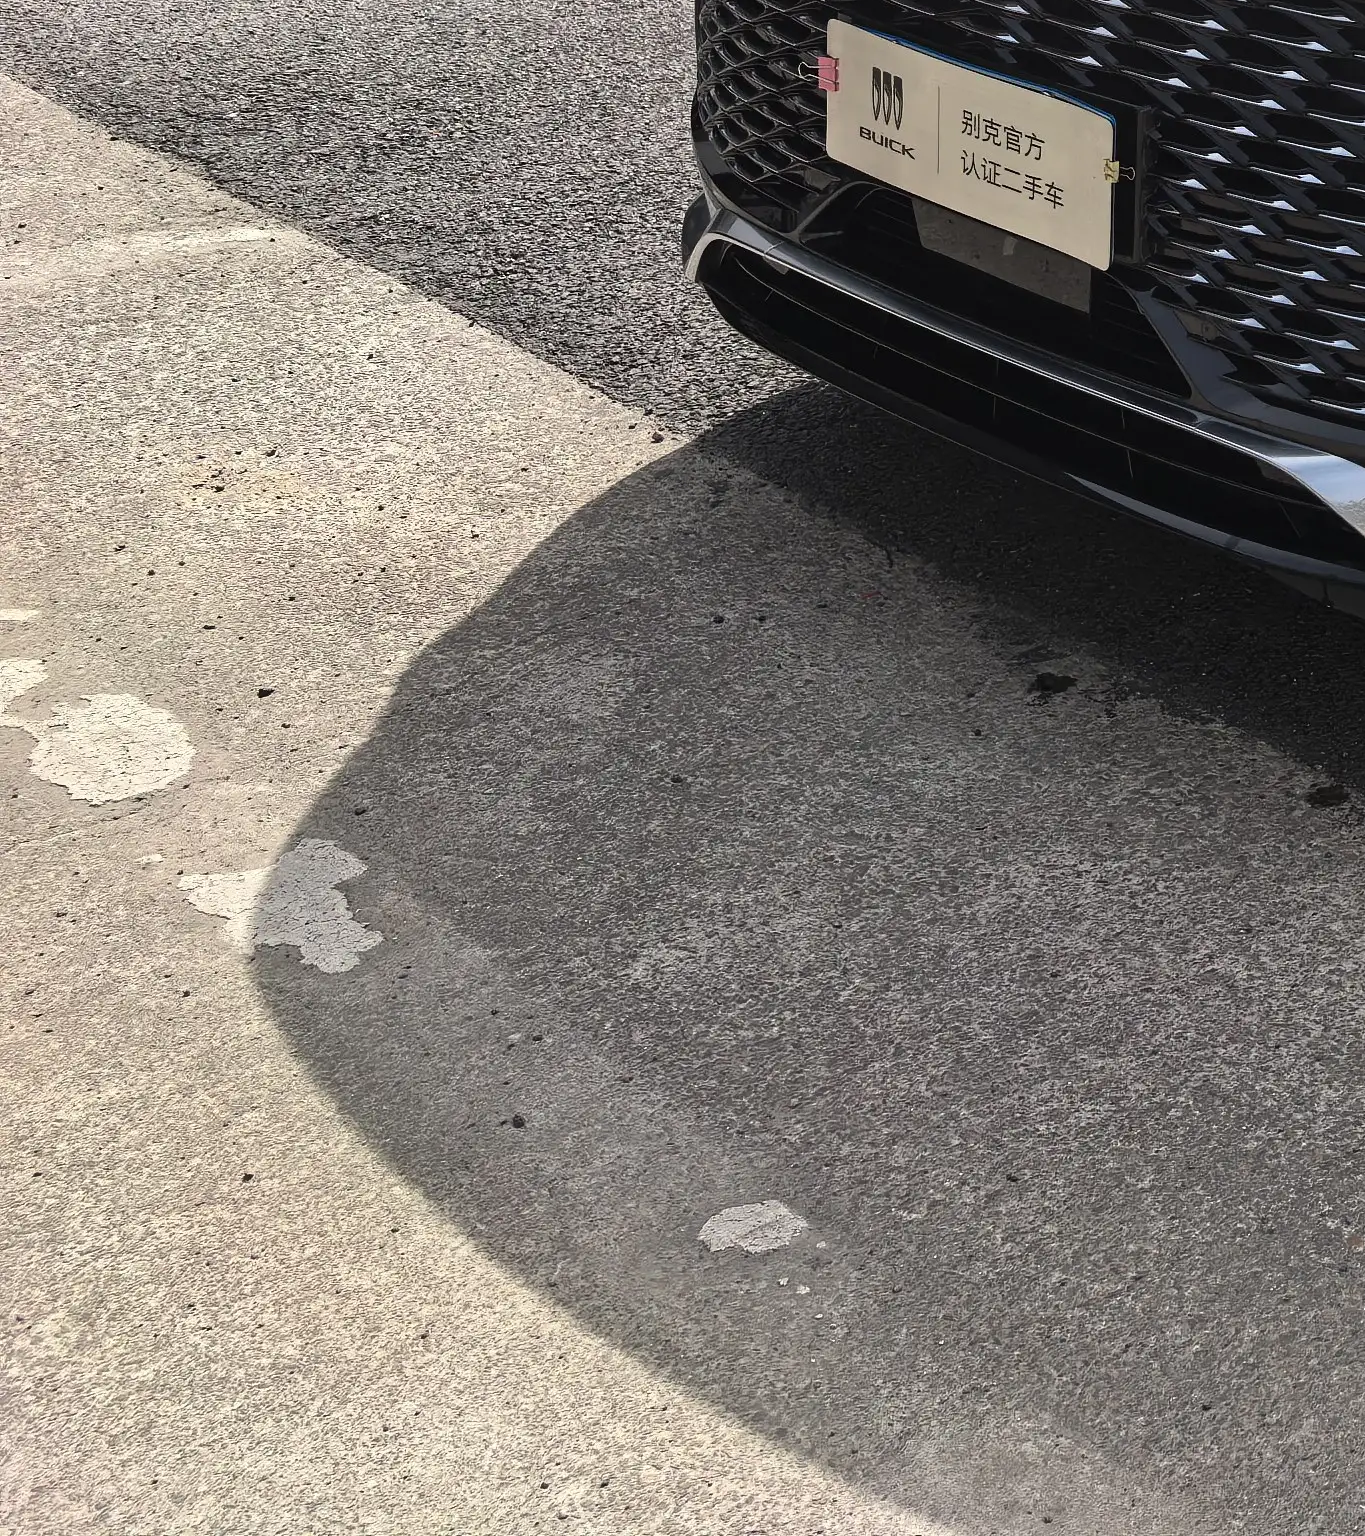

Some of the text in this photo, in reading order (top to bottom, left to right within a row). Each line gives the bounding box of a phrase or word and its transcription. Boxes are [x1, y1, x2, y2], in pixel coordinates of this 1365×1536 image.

[859, 126, 916, 161] BUICK
[961, 109, 1046, 162] 别克官方
[960, 149, 1065, 210] 认证二手车
